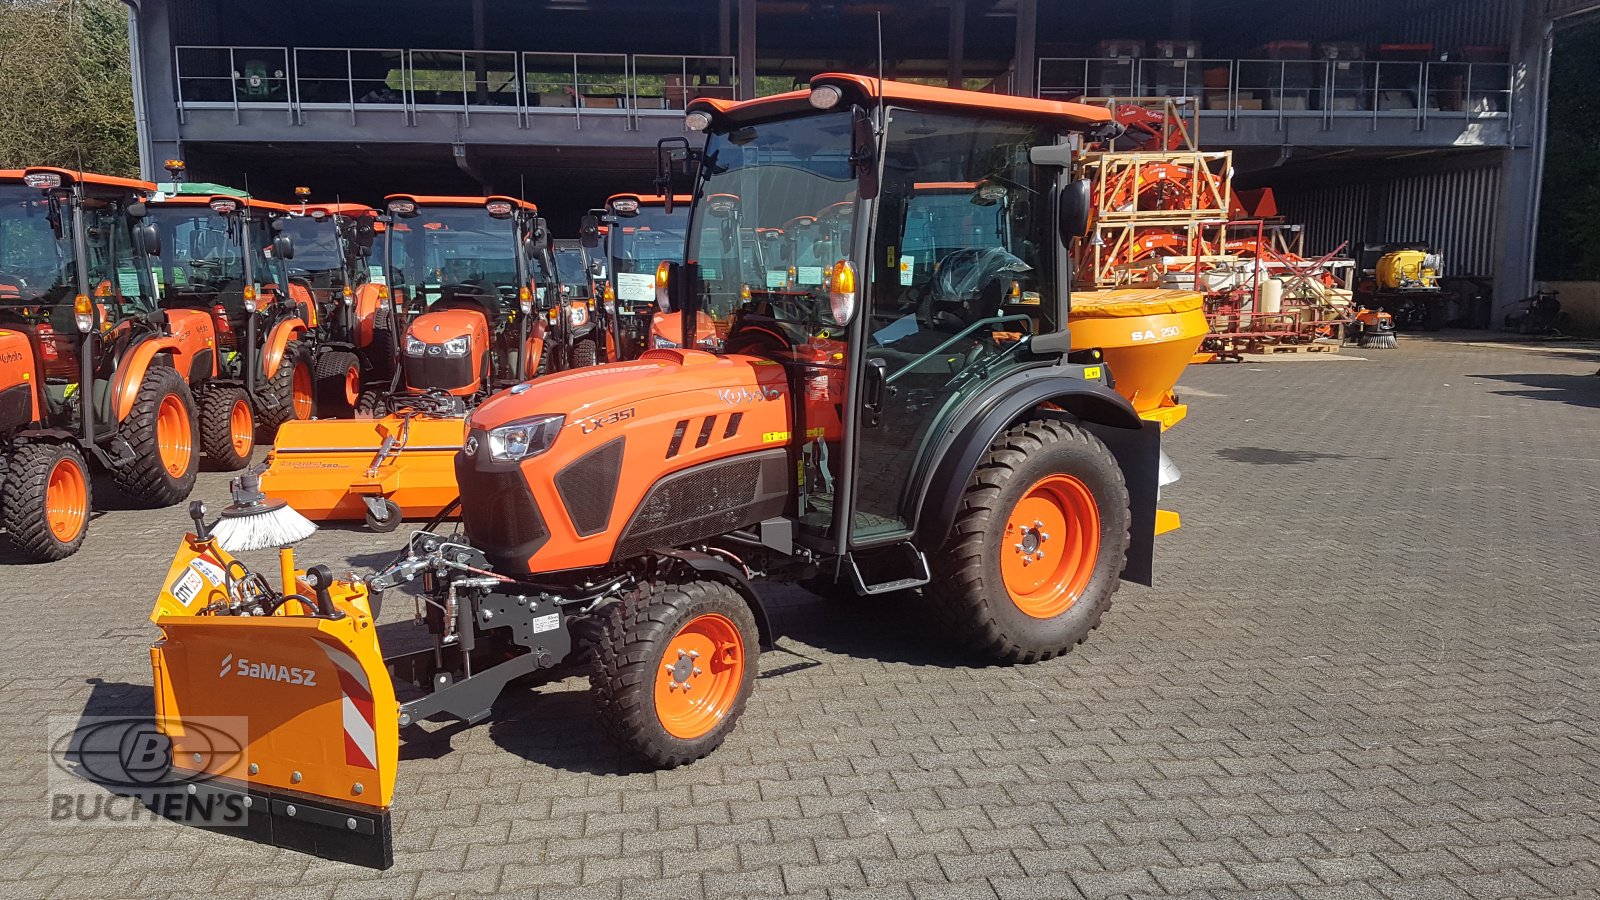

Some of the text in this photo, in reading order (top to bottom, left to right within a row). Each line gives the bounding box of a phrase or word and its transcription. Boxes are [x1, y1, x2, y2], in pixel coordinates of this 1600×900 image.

[1131, 326, 1179, 341] SA 250
[718, 385, 780, 405] Kubota
[581, 407, 635, 435] LX-351
[175, 582, 193, 604] CITY
[236, 658, 317, 687] SaMASZ
